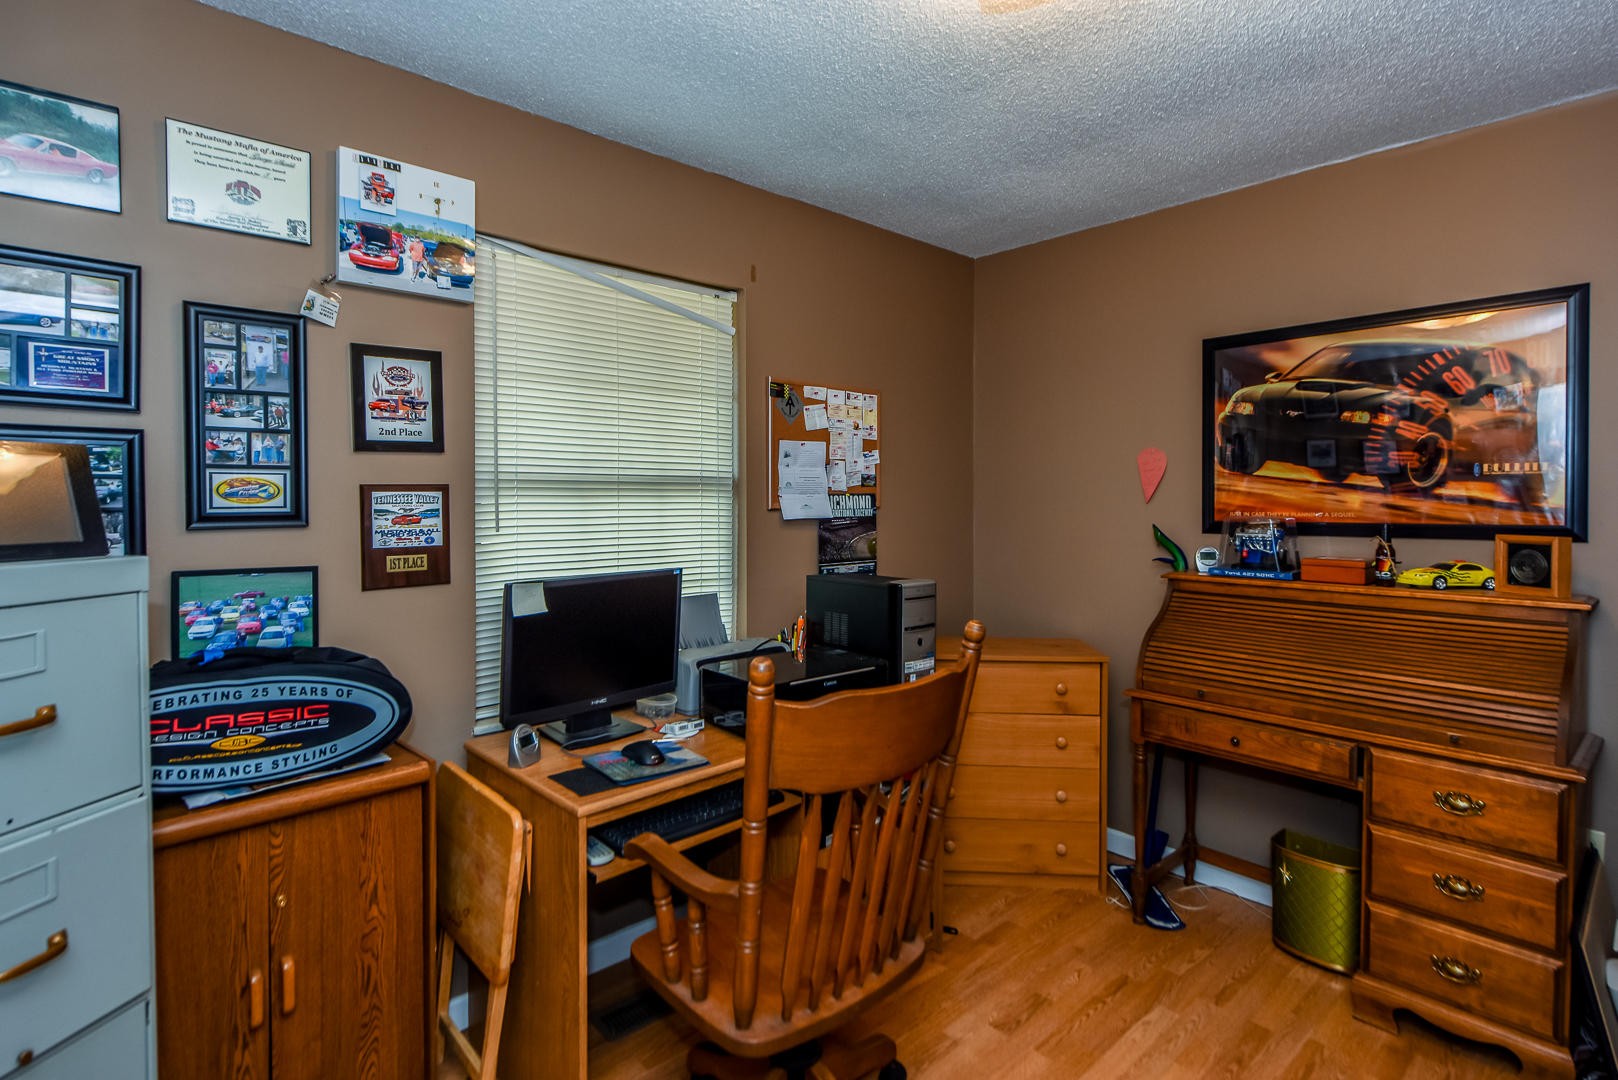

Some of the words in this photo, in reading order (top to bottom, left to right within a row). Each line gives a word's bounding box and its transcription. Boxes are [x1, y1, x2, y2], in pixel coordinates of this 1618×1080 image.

[176, 127, 193, 136] The
[196, 132, 233, 146] Mustang
[235, 142, 259, 151] Mafia
[270, 149, 302, 162] America
[1482, 350, 1512, 378] 70
[1442, 366, 1476, 395] 60
[378, 427, 397, 436] 2nd
[399, 427, 423, 437] Place
[373, 493, 413, 505] TENNESSEE
[413, 493, 440, 504] VALLEY
[831, 494, 872, 509] ICHMOND
[389, 557, 402, 570] 1ST
[402, 556, 425, 569] PLACE
[152, 690, 243, 711] EBRATING
[251, 687, 269, 698] 25
[278, 686, 328, 697] YEARS
[335, 688, 353, 699] OF
[150, 704, 330, 735] CLASSIC
[153, 730, 217, 743] ESIGN
[226, 717, 330, 737] CONCEPTS
[152, 762, 263, 781] RFORMANCE
[271, 743, 338, 770] STYLING
